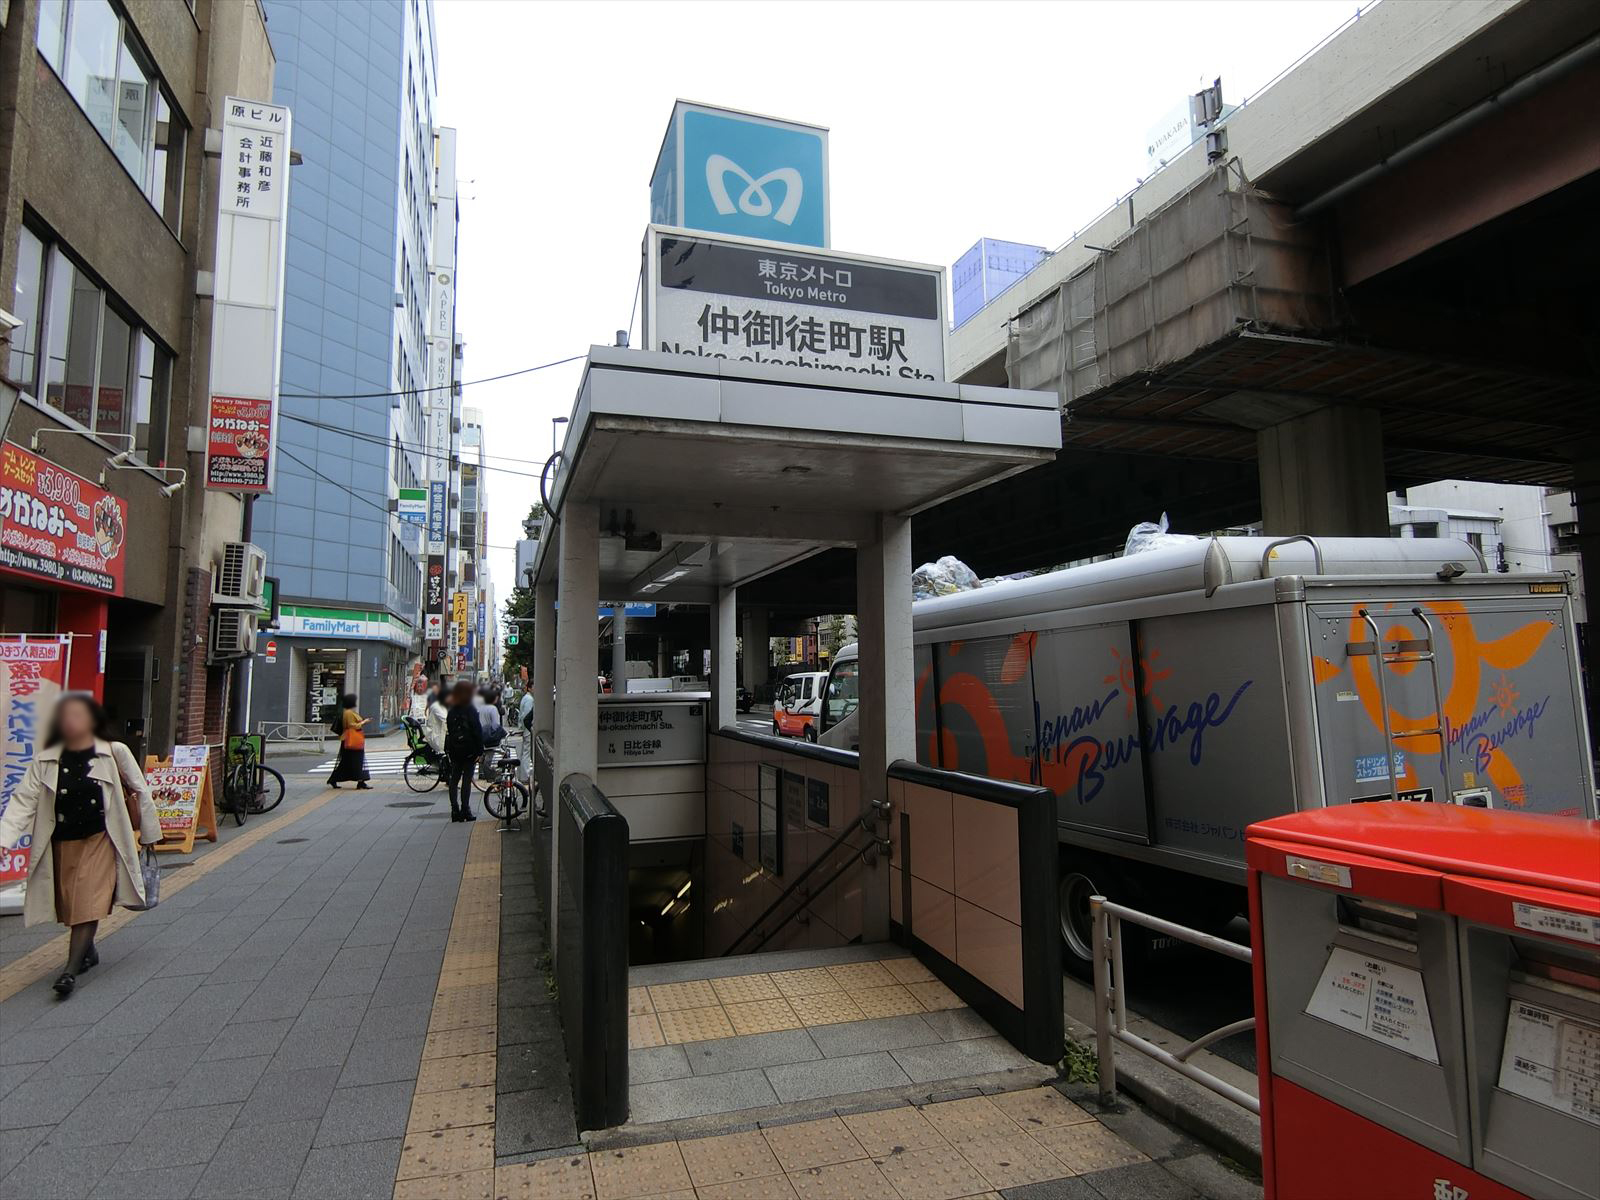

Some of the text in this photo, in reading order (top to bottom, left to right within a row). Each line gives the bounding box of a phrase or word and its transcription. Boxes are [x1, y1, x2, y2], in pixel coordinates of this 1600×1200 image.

[232, 106, 282, 122] 原ビル
[236, 138, 252, 208] 会計事務所
[258, 136, 273, 192] 近藤和彦
[758, 259, 851, 288] 東京メトロ
[764, 280, 846, 304] Tokyo Metro
[440, 290, 448, 330] APRE
[697, 304, 908, 363] 仲御徒町駅
[4, 462, 34, 486] ケースセット
[302, 619, 360, 634] FamilyMart
[310, 662, 324, 722] FamilyMart
[624, 740, 661, 750] 日比谷線
[1030, 689, 1119, 783] Japan
[1064, 681, 1253, 804] Beverage
[1440, 704, 1497, 776] Japan
[1467, 696, 1550, 774] Beverage
[1356, 756, 1386, 769] アイドリング
[1514, 1059, 1538, 1073] 連絡先
